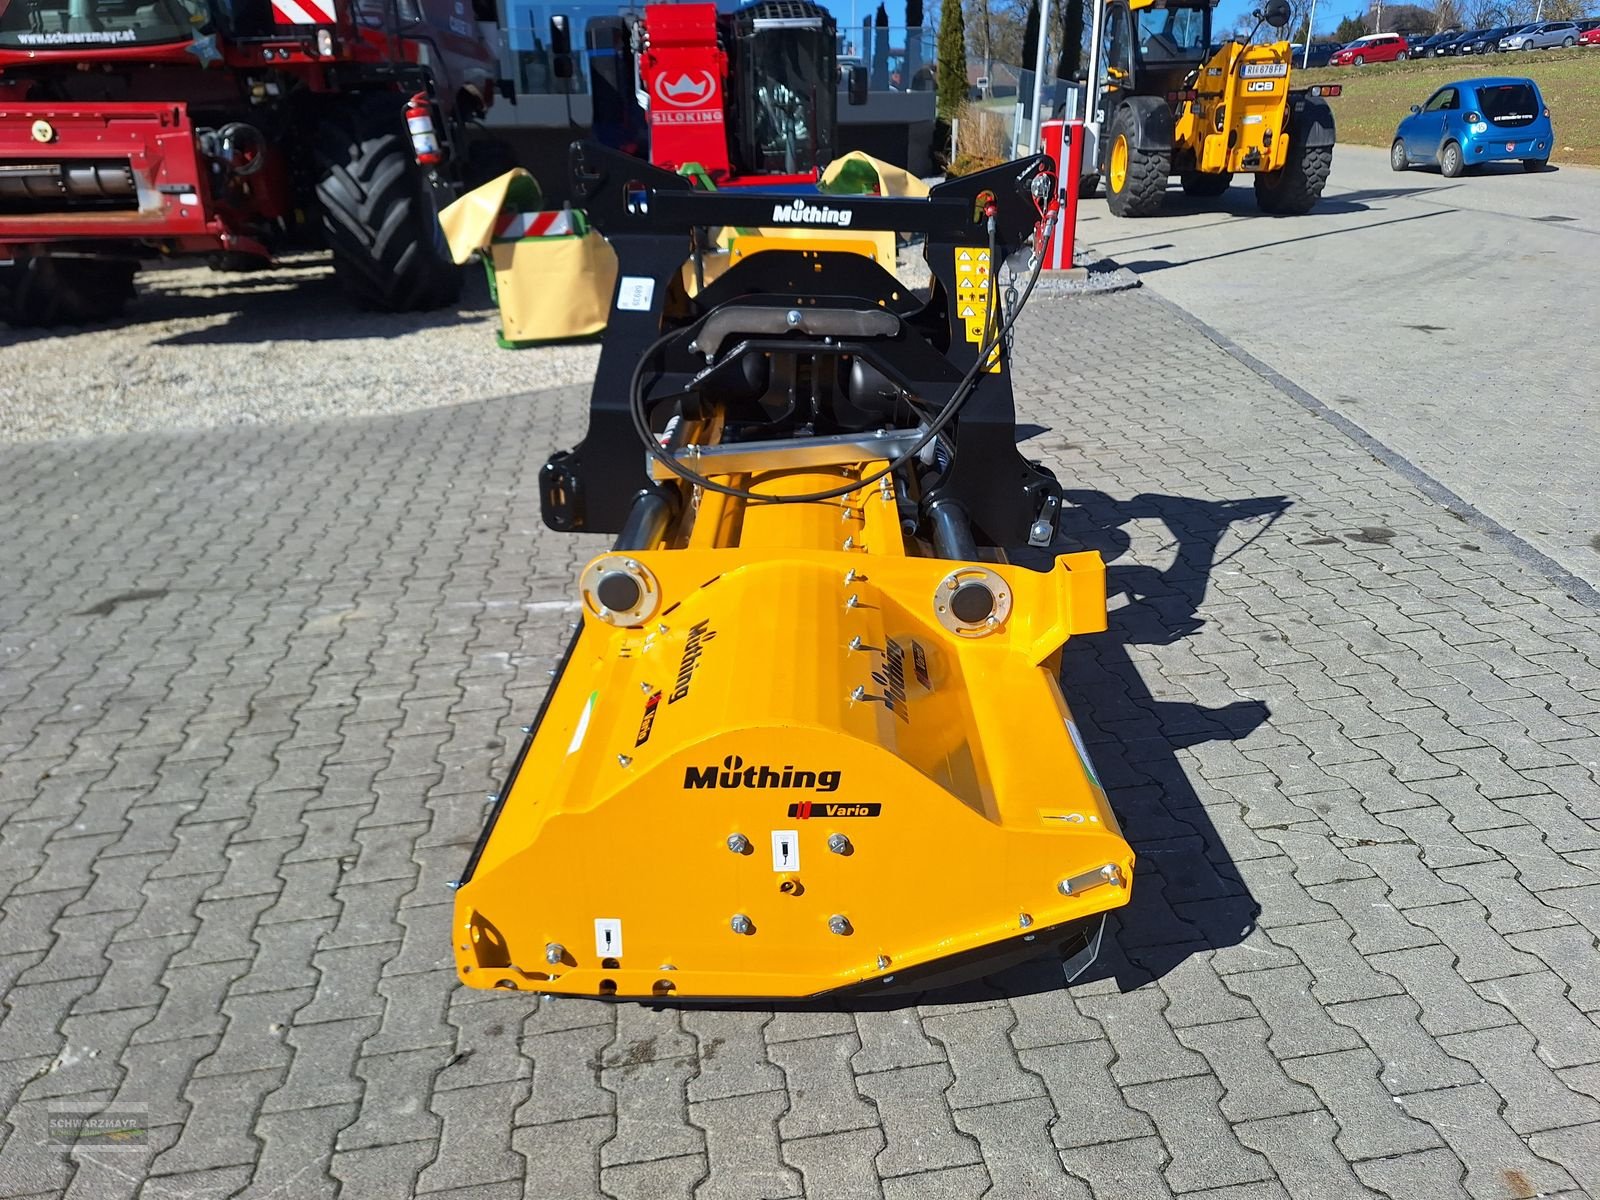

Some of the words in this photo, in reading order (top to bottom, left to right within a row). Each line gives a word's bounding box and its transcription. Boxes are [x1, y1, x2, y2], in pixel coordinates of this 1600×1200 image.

[18, 30, 136, 43] www.schwarzmayr.at
[1248, 82, 1274, 91] JCB
[653, 111, 723, 122] SILOKING
[772, 199, 852, 226] Müthing
[668, 618, 717, 705] Müthing
[638, 710, 655, 740] Vario
[683, 755, 841, 792] Müthing
[825, 805, 869, 816] Vario
